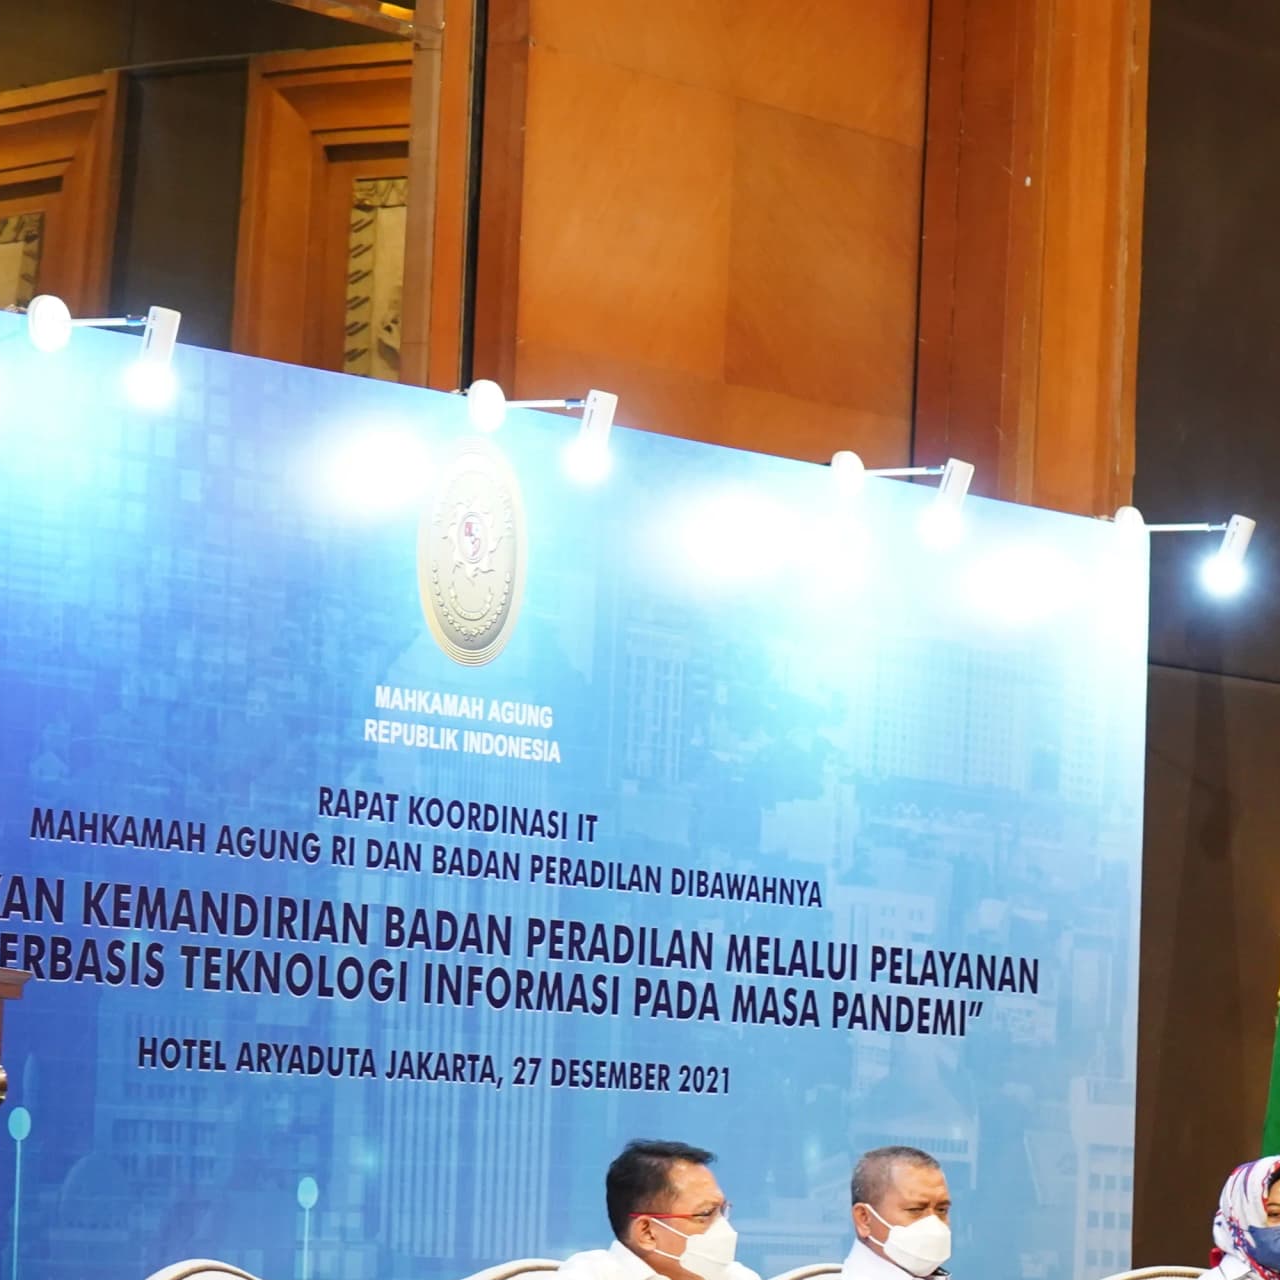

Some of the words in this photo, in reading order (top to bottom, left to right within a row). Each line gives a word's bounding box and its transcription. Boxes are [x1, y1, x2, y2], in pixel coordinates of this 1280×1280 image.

[374, 685, 484, 722] MAHKAMAH
[488, 701, 554, 729] AGUNG
[364, 718, 460, 752] REPUBLIK
[463, 730, 561, 763] INDONESIA
[319, 787, 398, 822] RAPAT
[409, 796, 567, 839] KOORDINASI
[578, 814, 597, 842] IT
[31, 808, 205, 852] MAHKAMAH
[216, 826, 320, 862] AGUNG
[333, 836, 354, 865] RI
[367, 839, 421, 871] DAN
[433, 846, 519, 880] BADAN
[531, 855, 661, 893] PERADILAN
[672, 868, 821, 907] DIBAWAHNYA
[83, 882, 369, 945] KEMANDIRIAN
[386, 907, 512, 956] BADAN
[527, 917, 713, 971] PERADILAN
[727, 934, 858, 981] MELALUI
[871, 946, 1039, 994] PELAYANAN
[181, 951, 408, 1002] TEKNOLOGI
[424, 967, 619, 1015] INFORMASI
[635, 978, 719, 1020] PADA
[732, 985, 819, 1027] MASA
[139, 1037, 225, 1070] HOTEL
[236, 1043, 376, 1077] ARYADUTA
[386, 1051, 502, 1088] JAKARTA,
[514, 1057, 541, 1084] 27
[552, 1059, 669, 1090] DESEMBER
[679, 1066, 728, 1093] 2021
